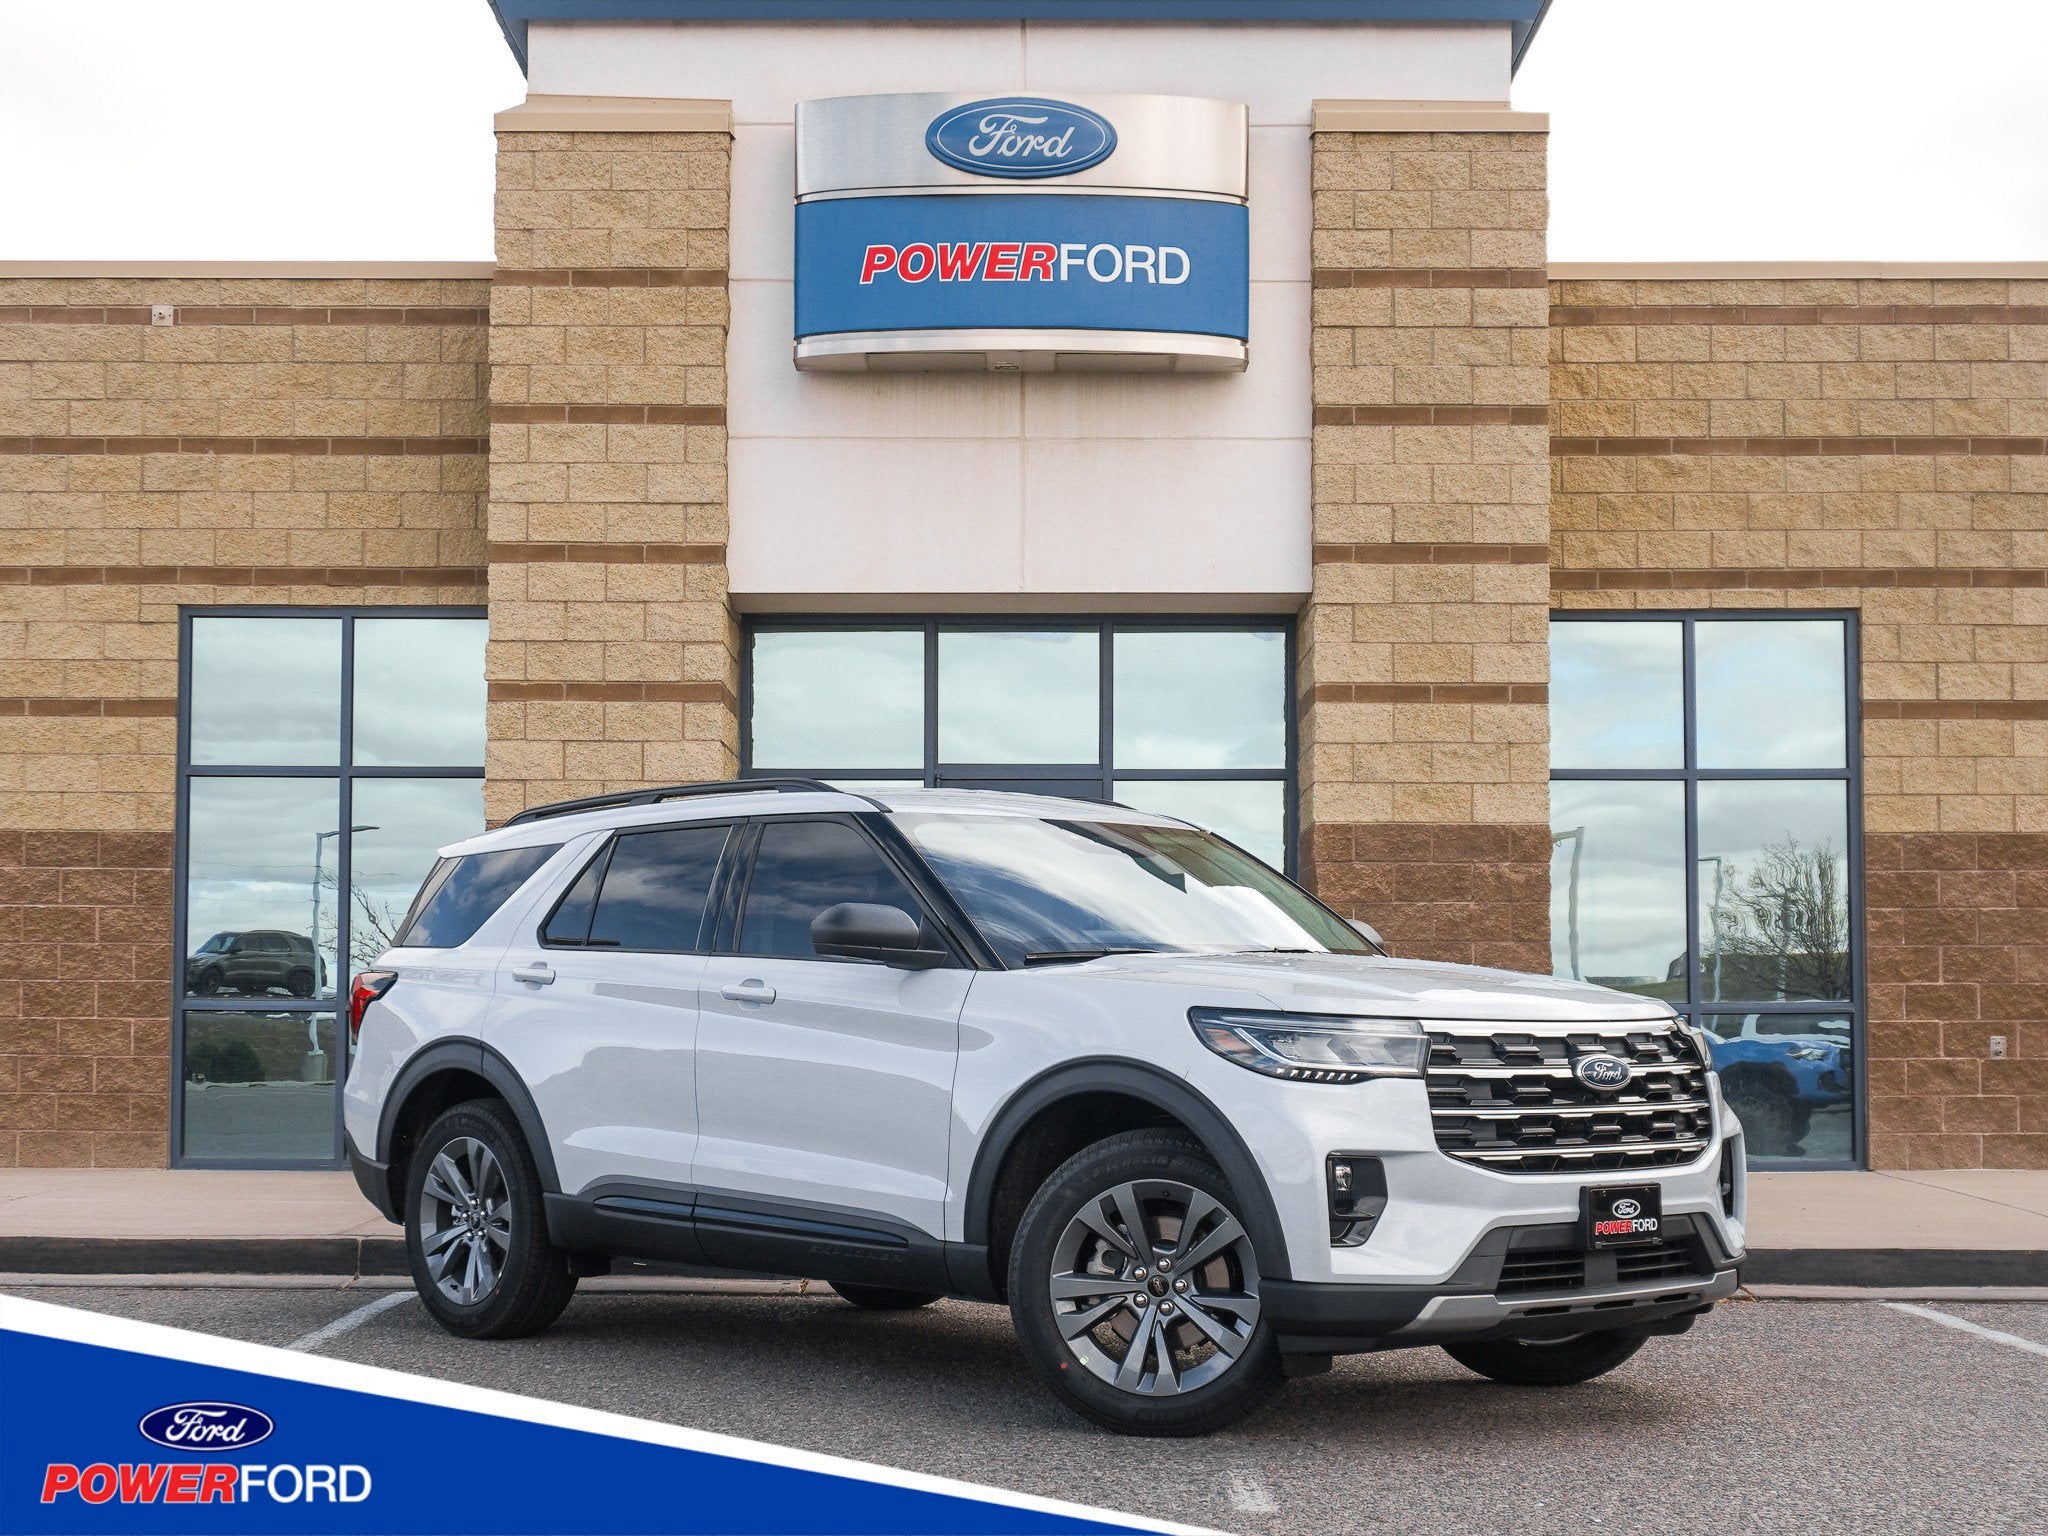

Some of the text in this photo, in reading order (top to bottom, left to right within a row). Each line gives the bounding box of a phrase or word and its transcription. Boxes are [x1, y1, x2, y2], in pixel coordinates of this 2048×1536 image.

[968, 113, 1073, 158] Ford
[859, 242, 1191, 285] POWERFORD
[1593, 1062, 1623, 1080] Ford
[1618, 1202, 1636, 1214] Ford
[1595, 1218, 1658, 1235] POWERFORD
